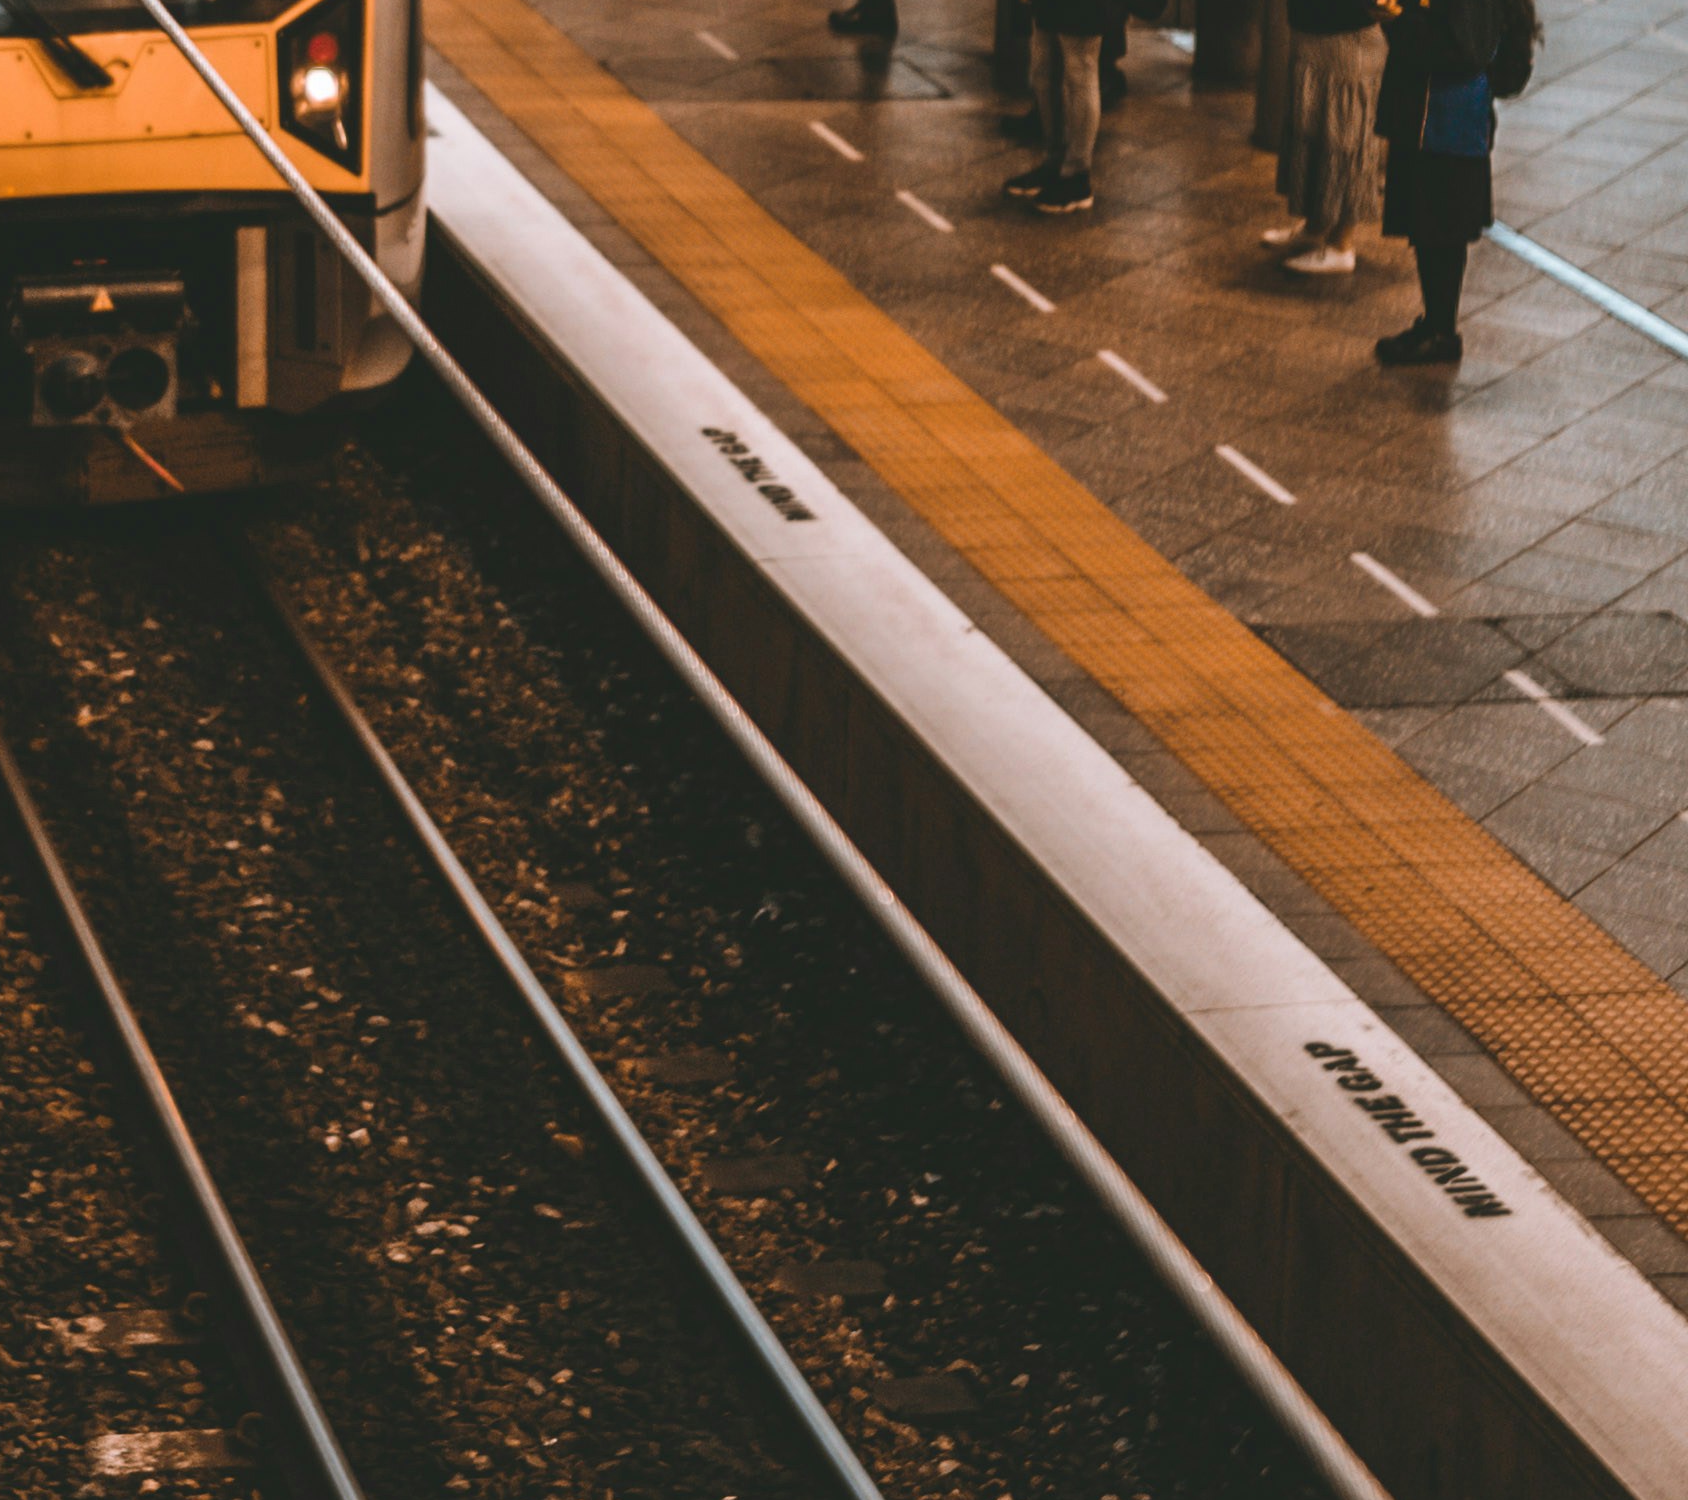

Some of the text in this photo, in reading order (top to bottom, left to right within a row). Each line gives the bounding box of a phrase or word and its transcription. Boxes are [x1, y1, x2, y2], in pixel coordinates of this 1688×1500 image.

[699, 427, 751, 456] GAP
[1302, 1041, 1513, 1218] MIND THE GAP
